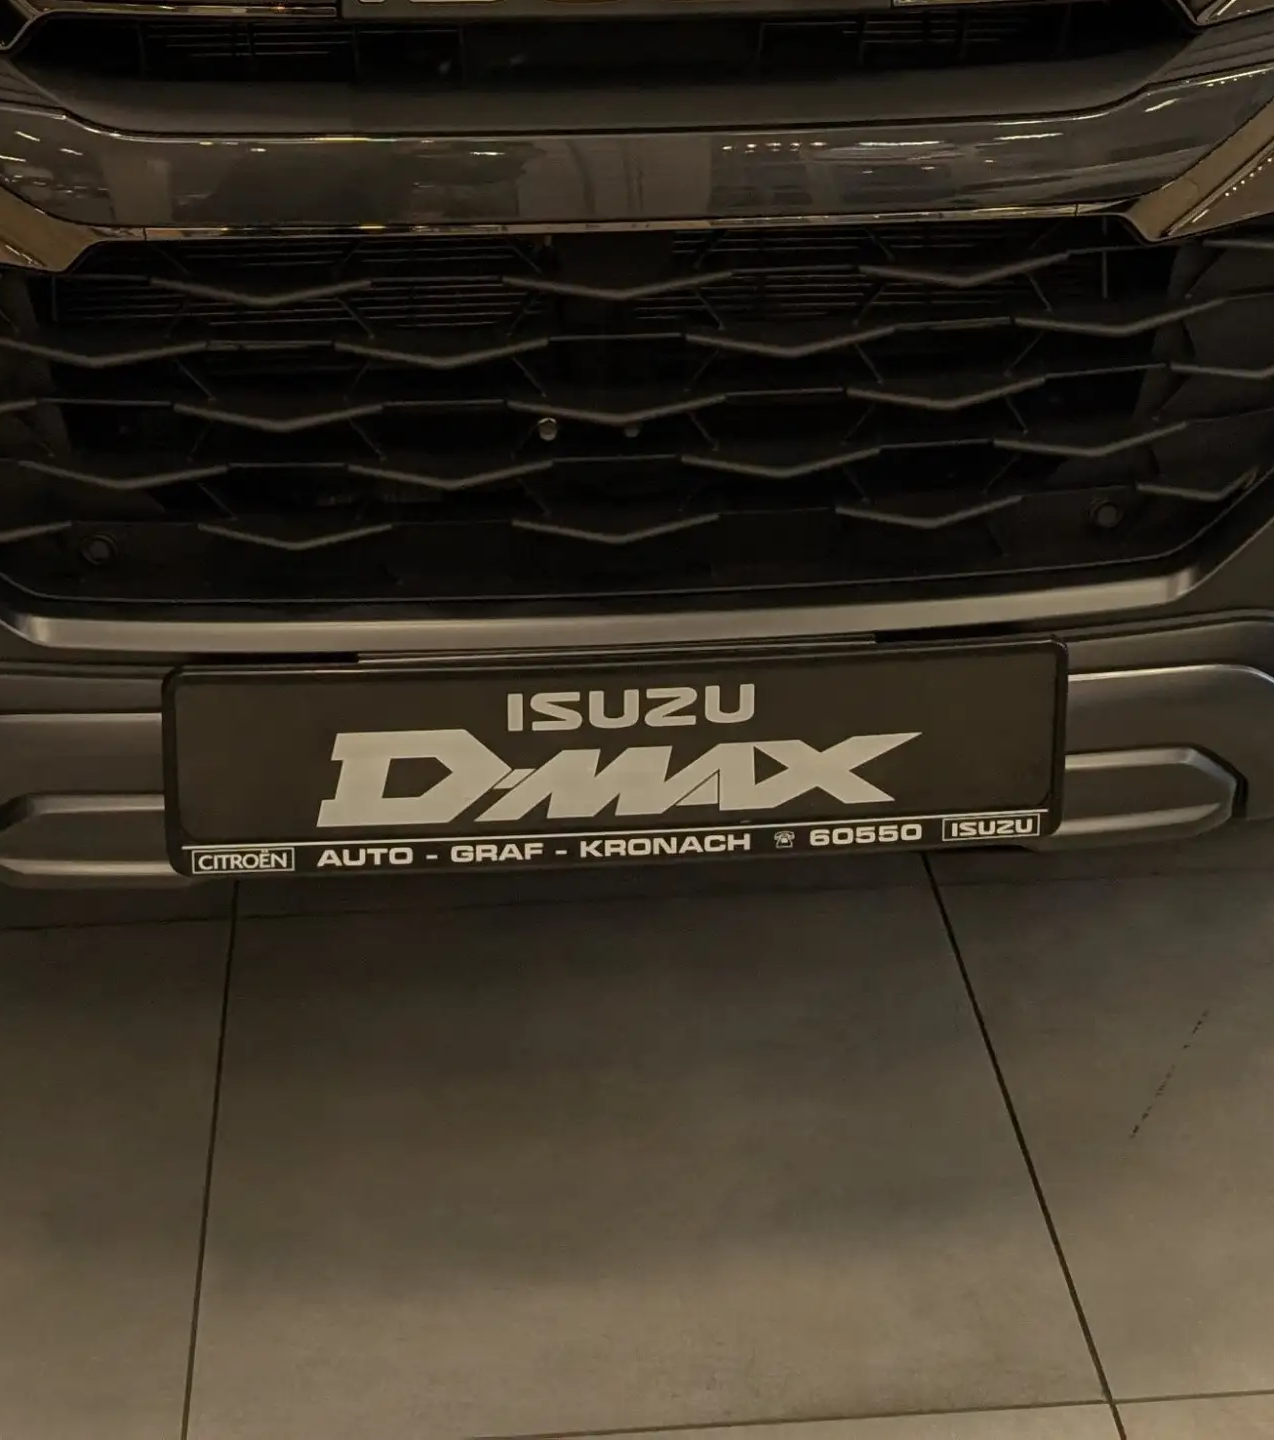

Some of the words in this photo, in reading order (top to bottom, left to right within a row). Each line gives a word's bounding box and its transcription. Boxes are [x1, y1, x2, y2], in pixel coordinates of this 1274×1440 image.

[506, 683, 756, 732] ISUZU
[951, 818, 1033, 837] ISUZU
[198, 849, 288, 871] CITROËN
[317, 846, 414, 868] AUTO
[450, 842, 544, 863] GRAF
[579, 833, 751, 858] KRONACH
[809, 823, 923, 847] 60550
